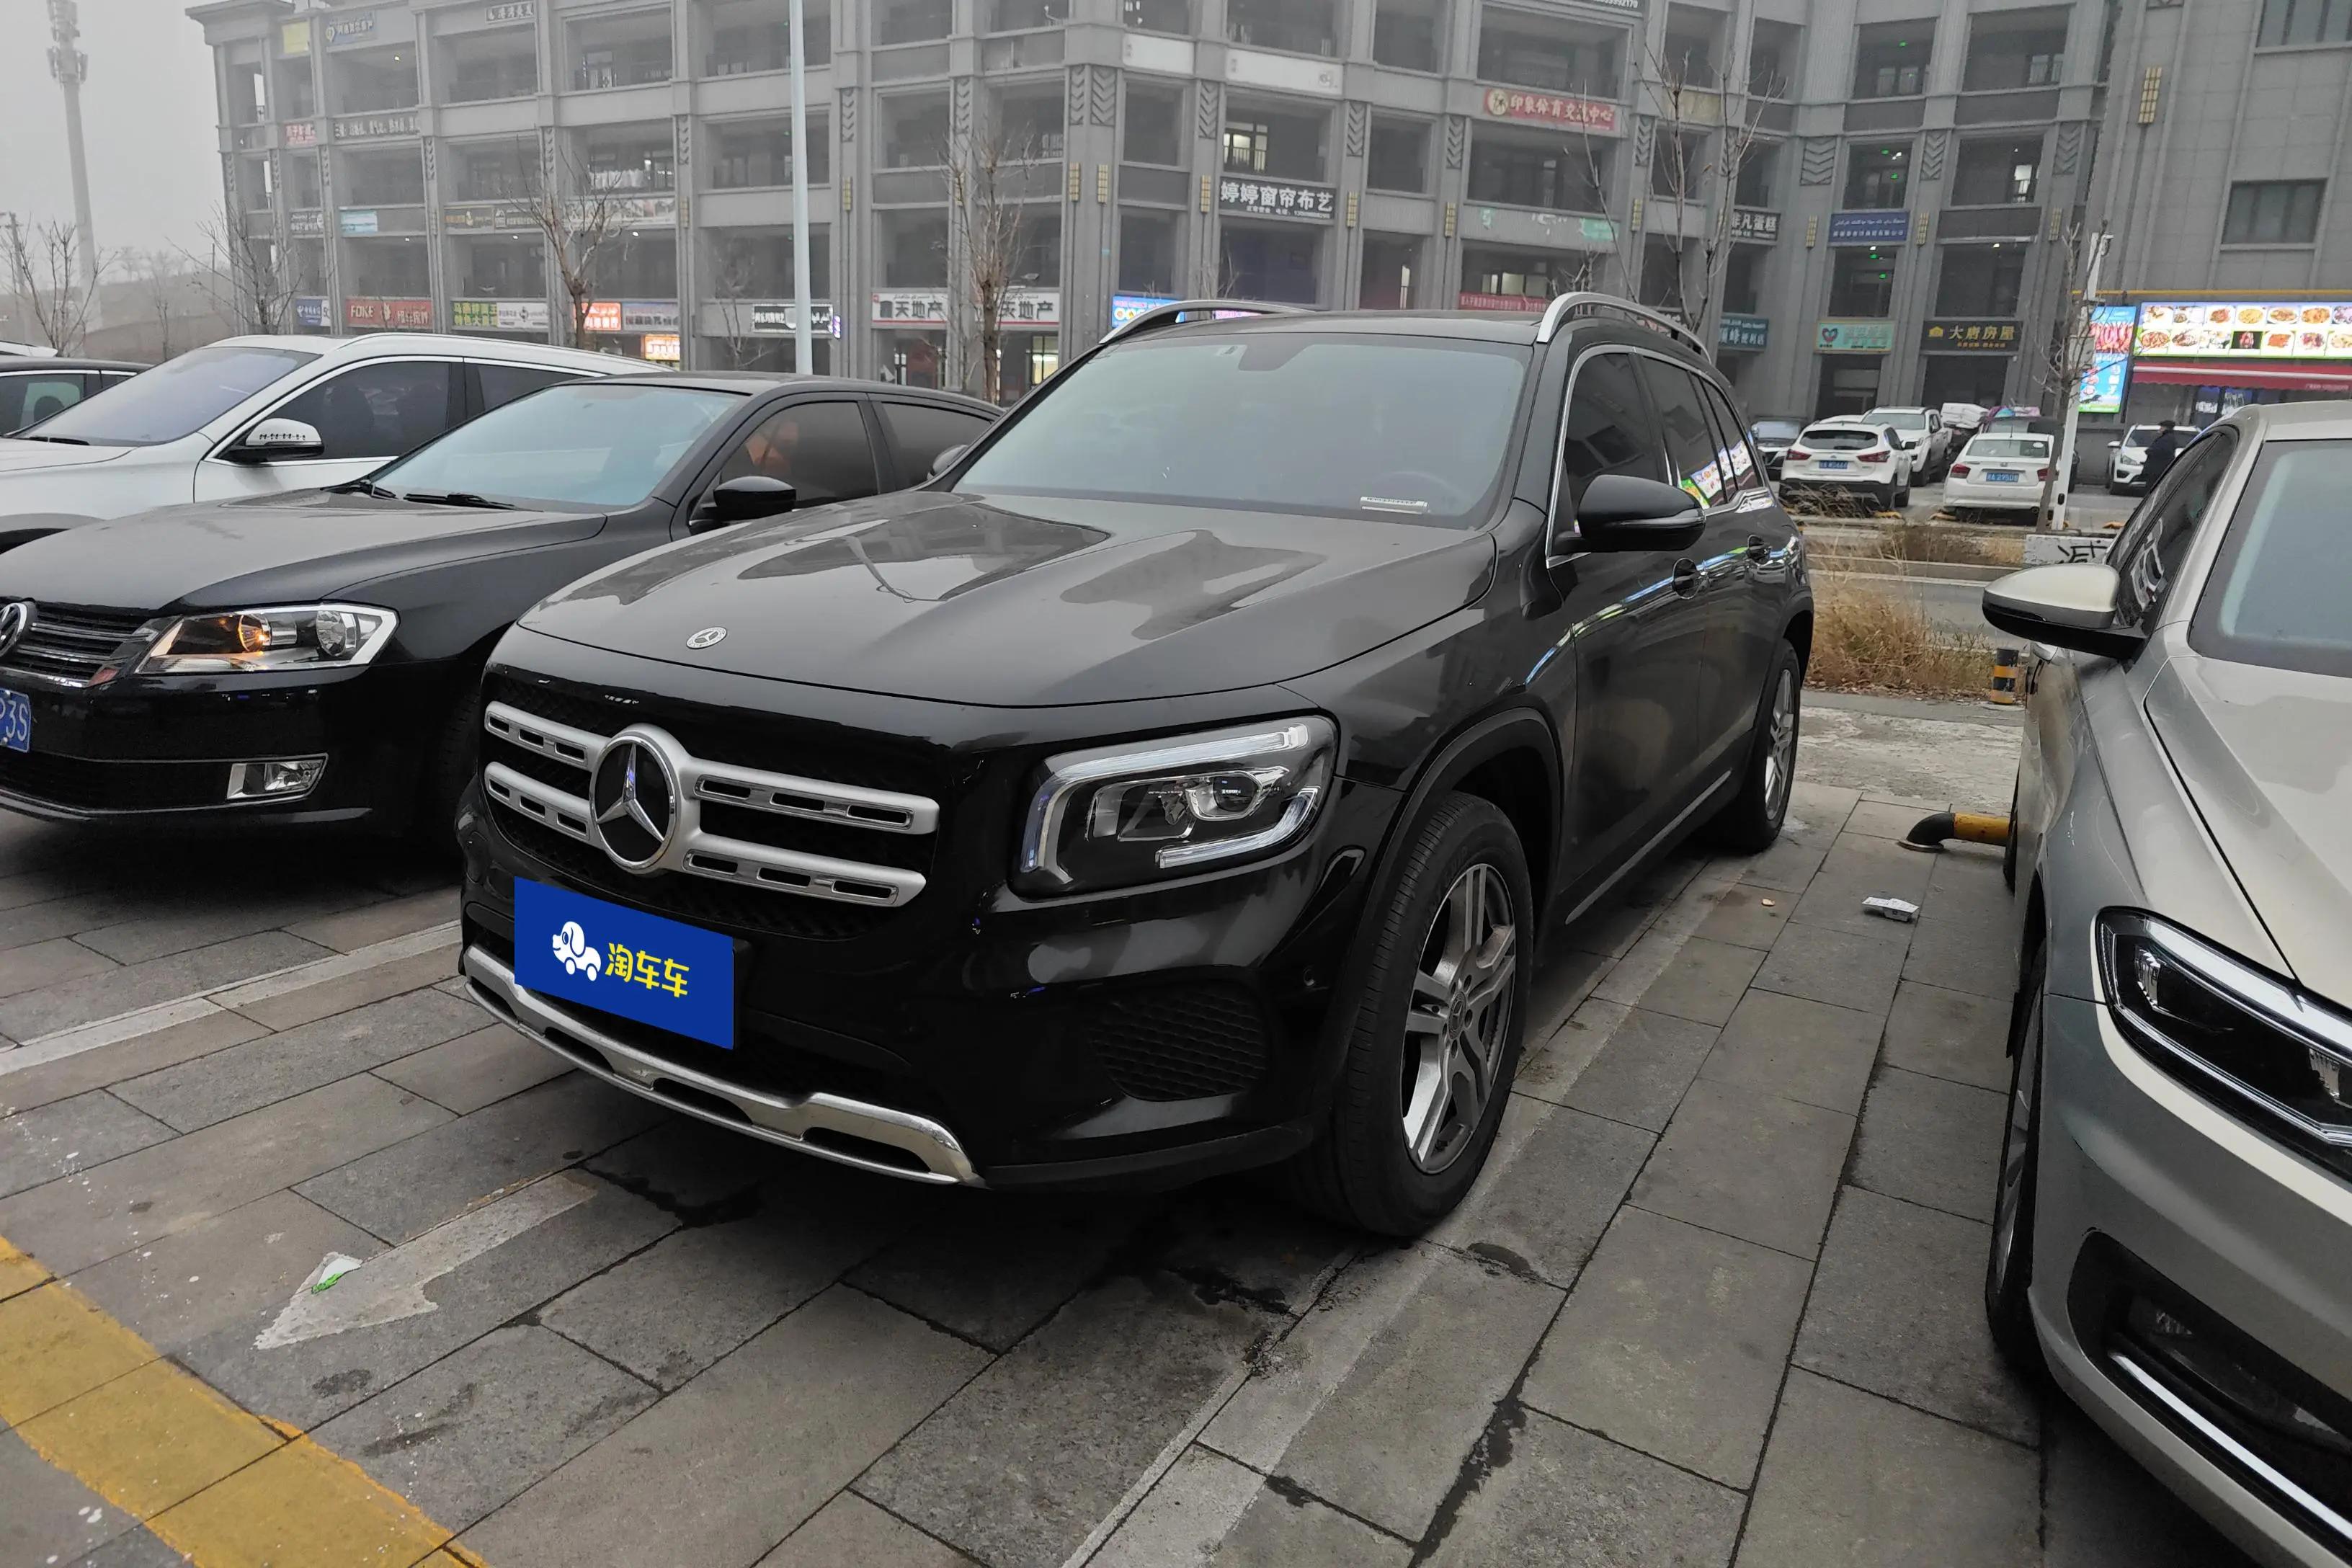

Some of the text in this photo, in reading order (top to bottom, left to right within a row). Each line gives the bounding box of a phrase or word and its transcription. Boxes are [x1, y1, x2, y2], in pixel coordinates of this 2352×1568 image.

[1220, 181, 1333, 213] 婷婷窗帘布艺
[1948, 325, 2015, 340] 大唐房屋
